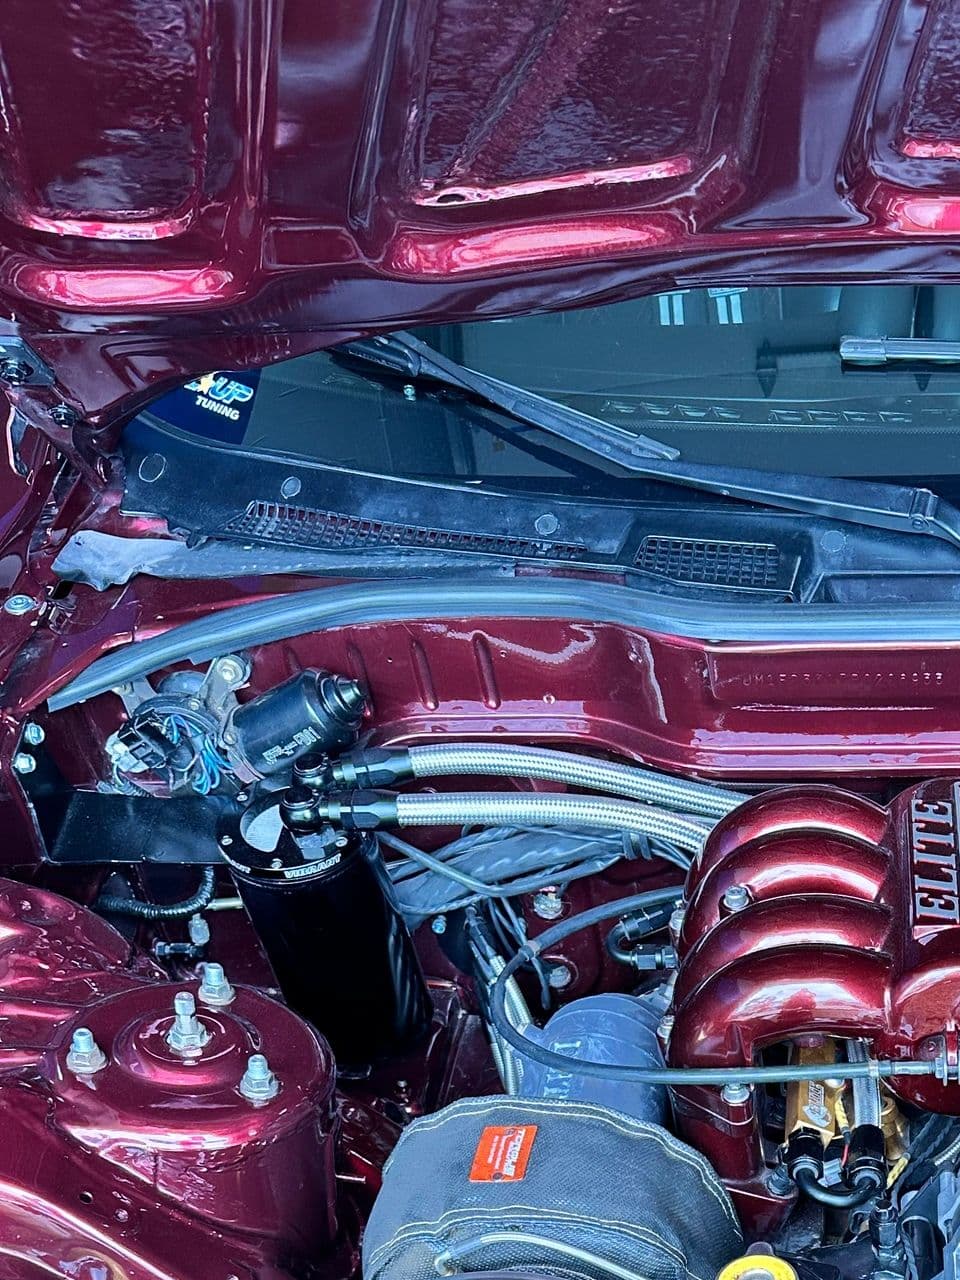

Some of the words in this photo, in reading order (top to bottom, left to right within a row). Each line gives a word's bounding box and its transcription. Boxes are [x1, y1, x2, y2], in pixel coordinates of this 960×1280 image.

[195, 396, 241, 421] TUNING
[283, 853, 342, 879] VIBRANT
[911, 799, 960, 925] ELITE
